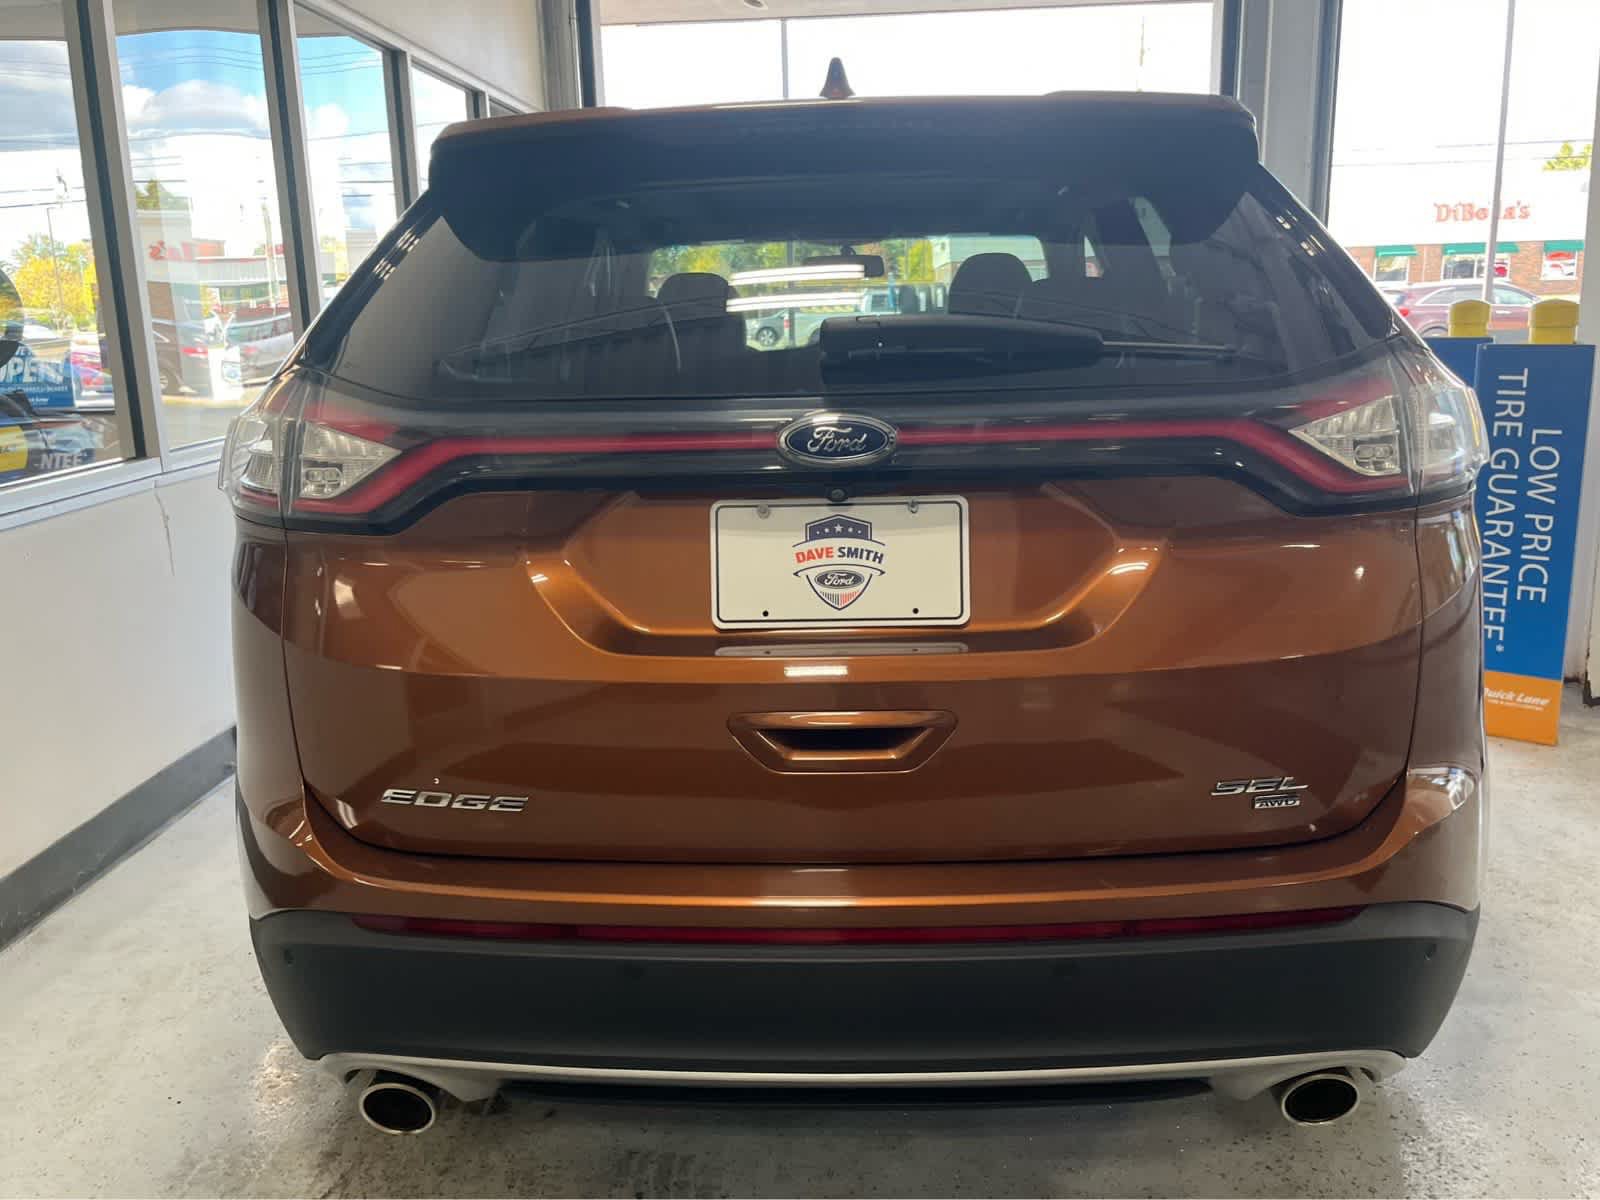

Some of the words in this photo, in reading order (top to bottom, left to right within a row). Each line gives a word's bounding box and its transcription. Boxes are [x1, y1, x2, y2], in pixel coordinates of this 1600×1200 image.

[1493, 367, 1529, 437] TIRE
[807, 426, 868, 452] Ford
[1526, 428, 1563, 504] LOW
[795, 547, 834, 564] DAVE
[837, 546, 884, 564] SMITH
[1516, 513, 1554, 603] PRICE
[1211, 776, 1309, 795] SEL
[381, 788, 529, 812] EDGE
